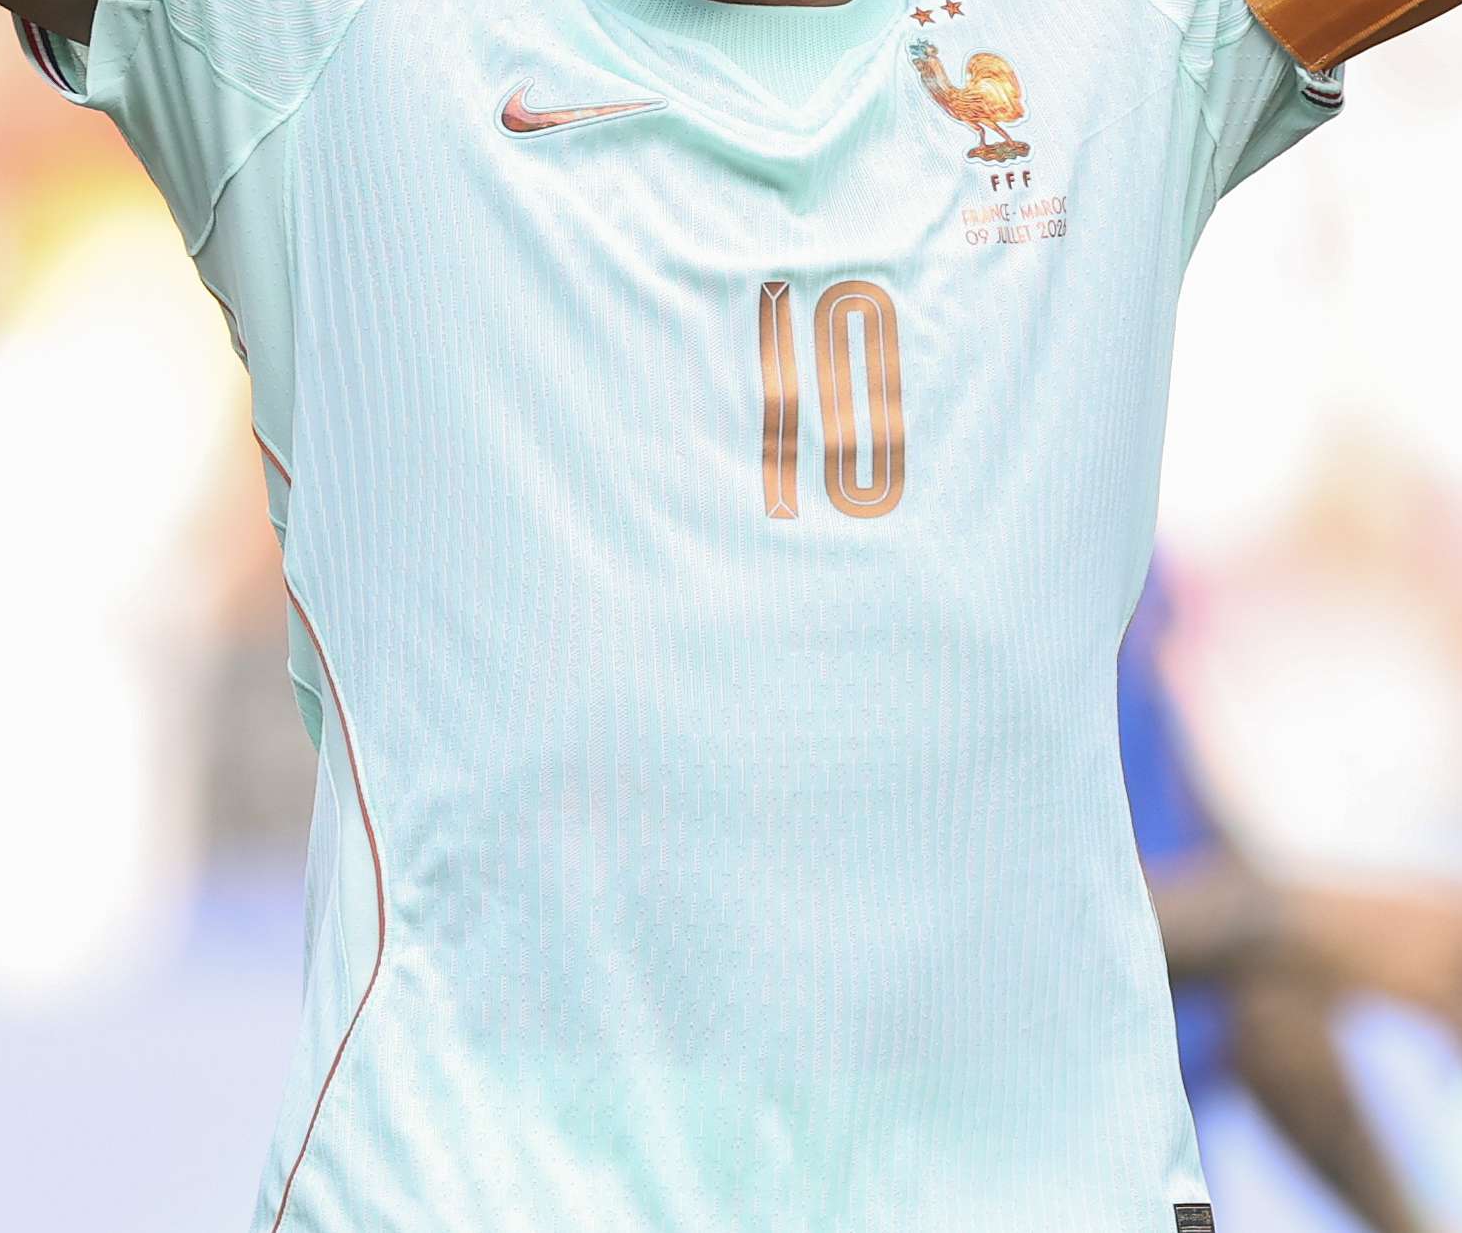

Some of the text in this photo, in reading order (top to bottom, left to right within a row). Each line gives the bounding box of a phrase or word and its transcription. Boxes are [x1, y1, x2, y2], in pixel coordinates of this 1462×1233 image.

[962, 203, 1010, 225] FRANCE
[965, 228, 989, 246] 09
[759, 280, 905, 519] 10
